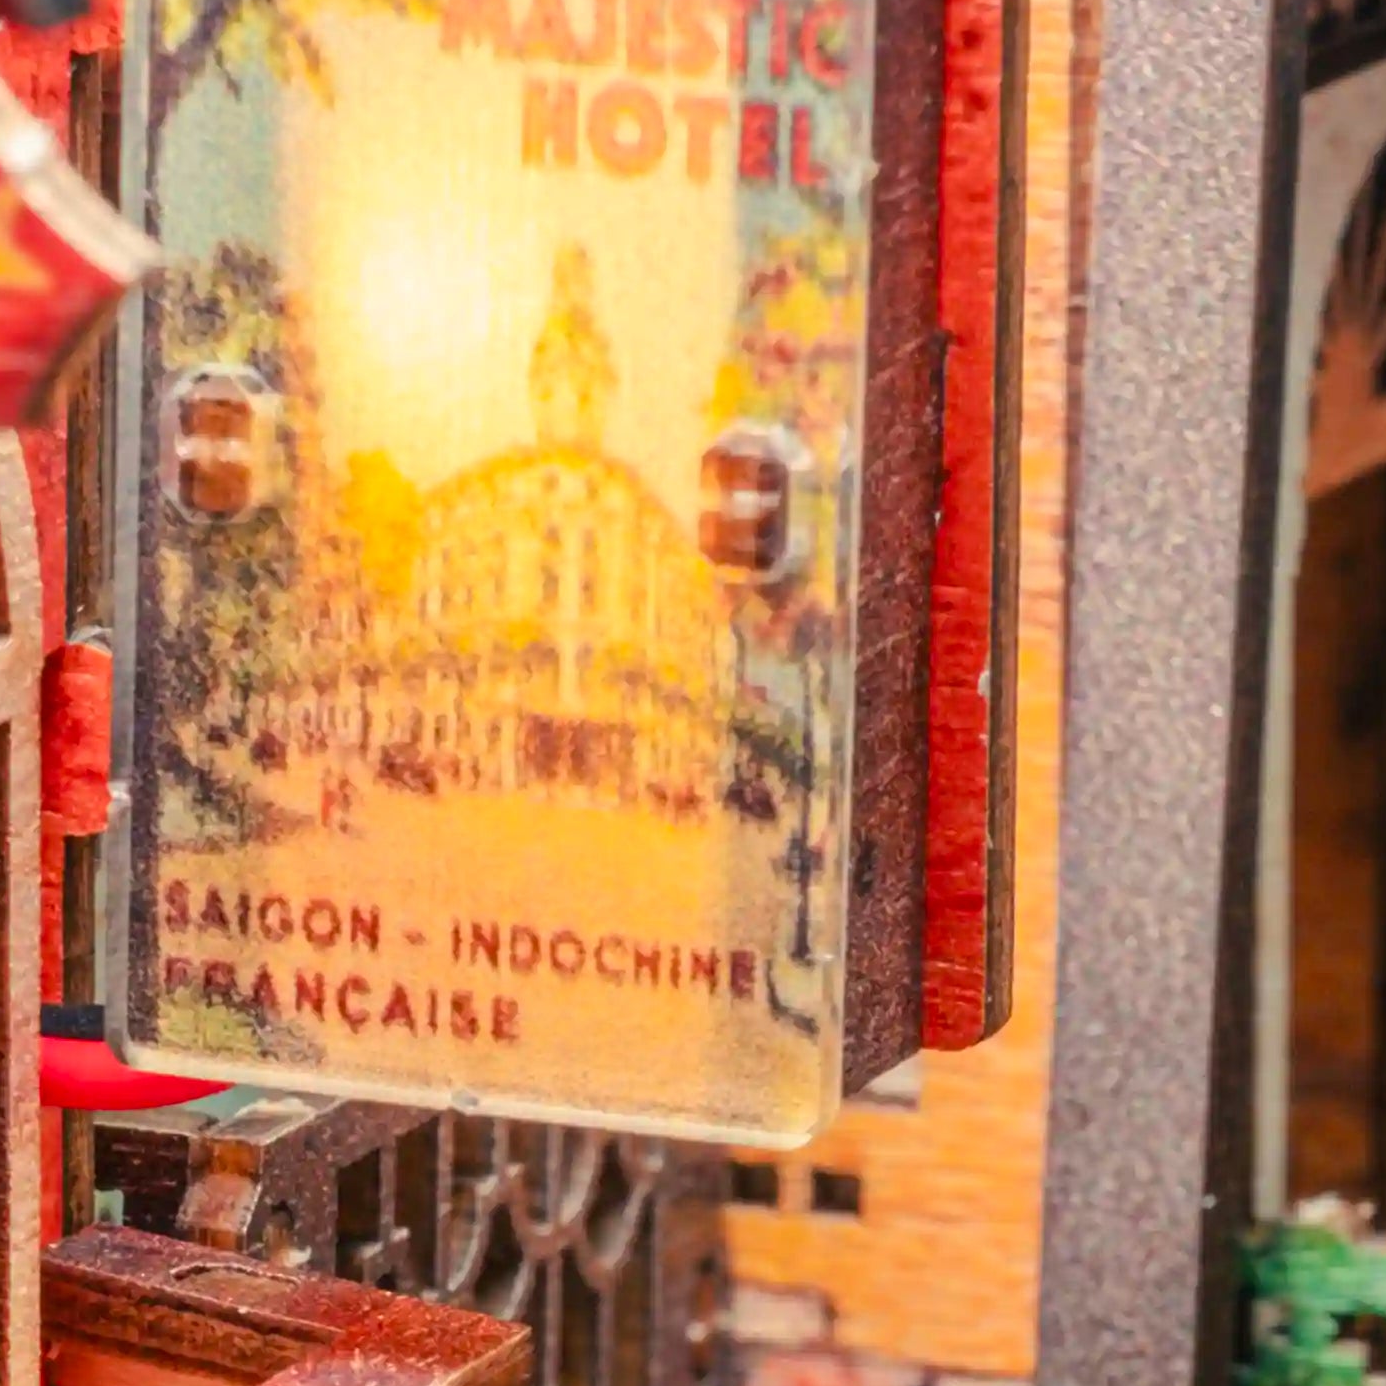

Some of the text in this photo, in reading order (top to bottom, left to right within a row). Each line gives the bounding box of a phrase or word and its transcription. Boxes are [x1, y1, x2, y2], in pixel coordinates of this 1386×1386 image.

[521, 77, 829, 186] HOTEL
[162, 879, 381, 952] SAIGON
[451, 918, 757, 1001] INDOCHINE
